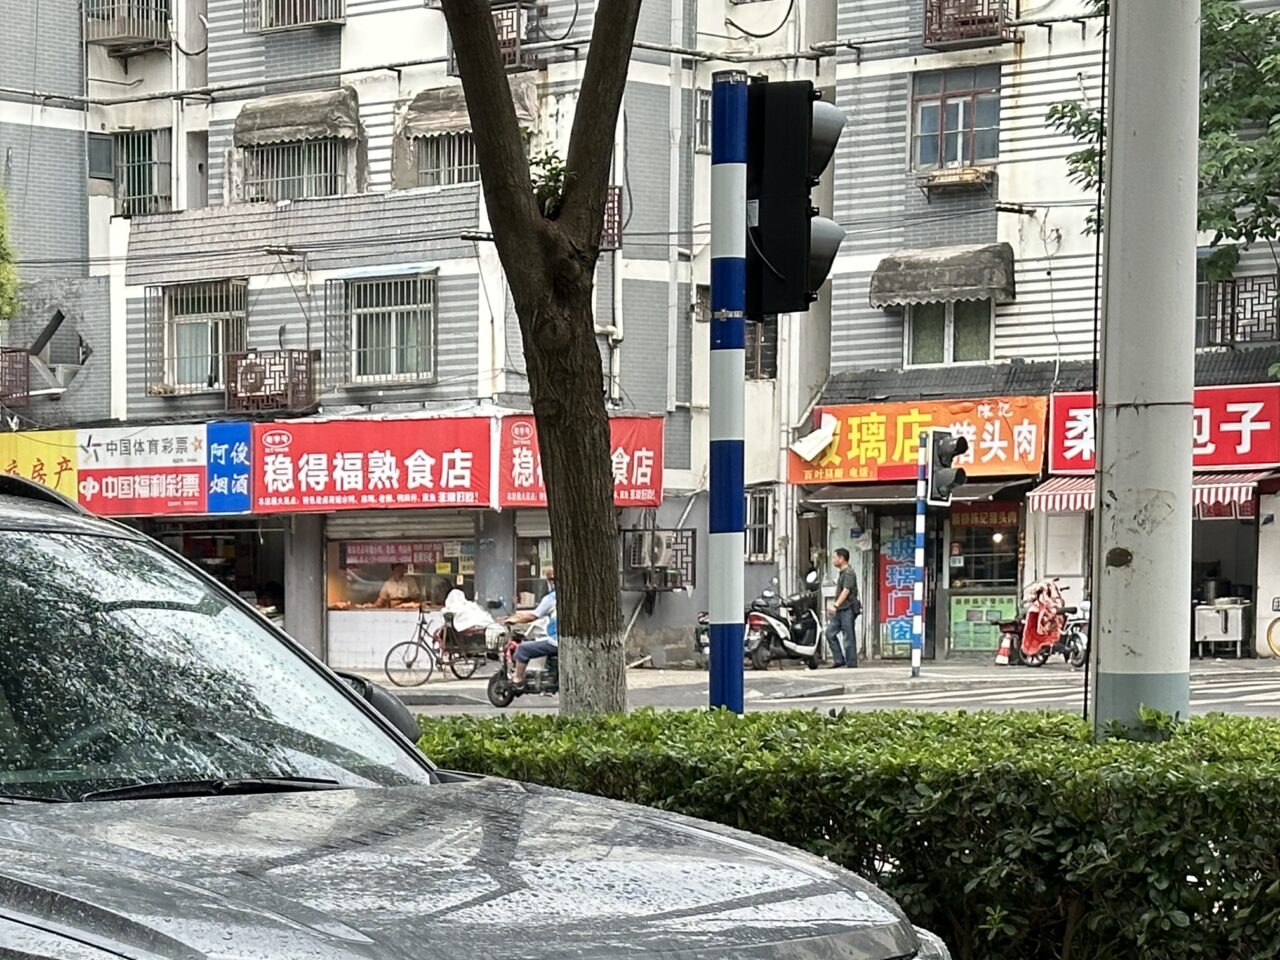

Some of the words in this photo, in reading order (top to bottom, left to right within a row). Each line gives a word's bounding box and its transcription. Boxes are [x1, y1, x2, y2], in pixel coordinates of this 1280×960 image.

[105, 435, 189, 457] 中国体育彩票
[209, 442, 251, 466] 阿俊
[263, 448, 473, 493] 稳得福熟食店
[101, 473, 200, 499] 中国福利彩票
[209, 473, 249, 496] 烟酒
